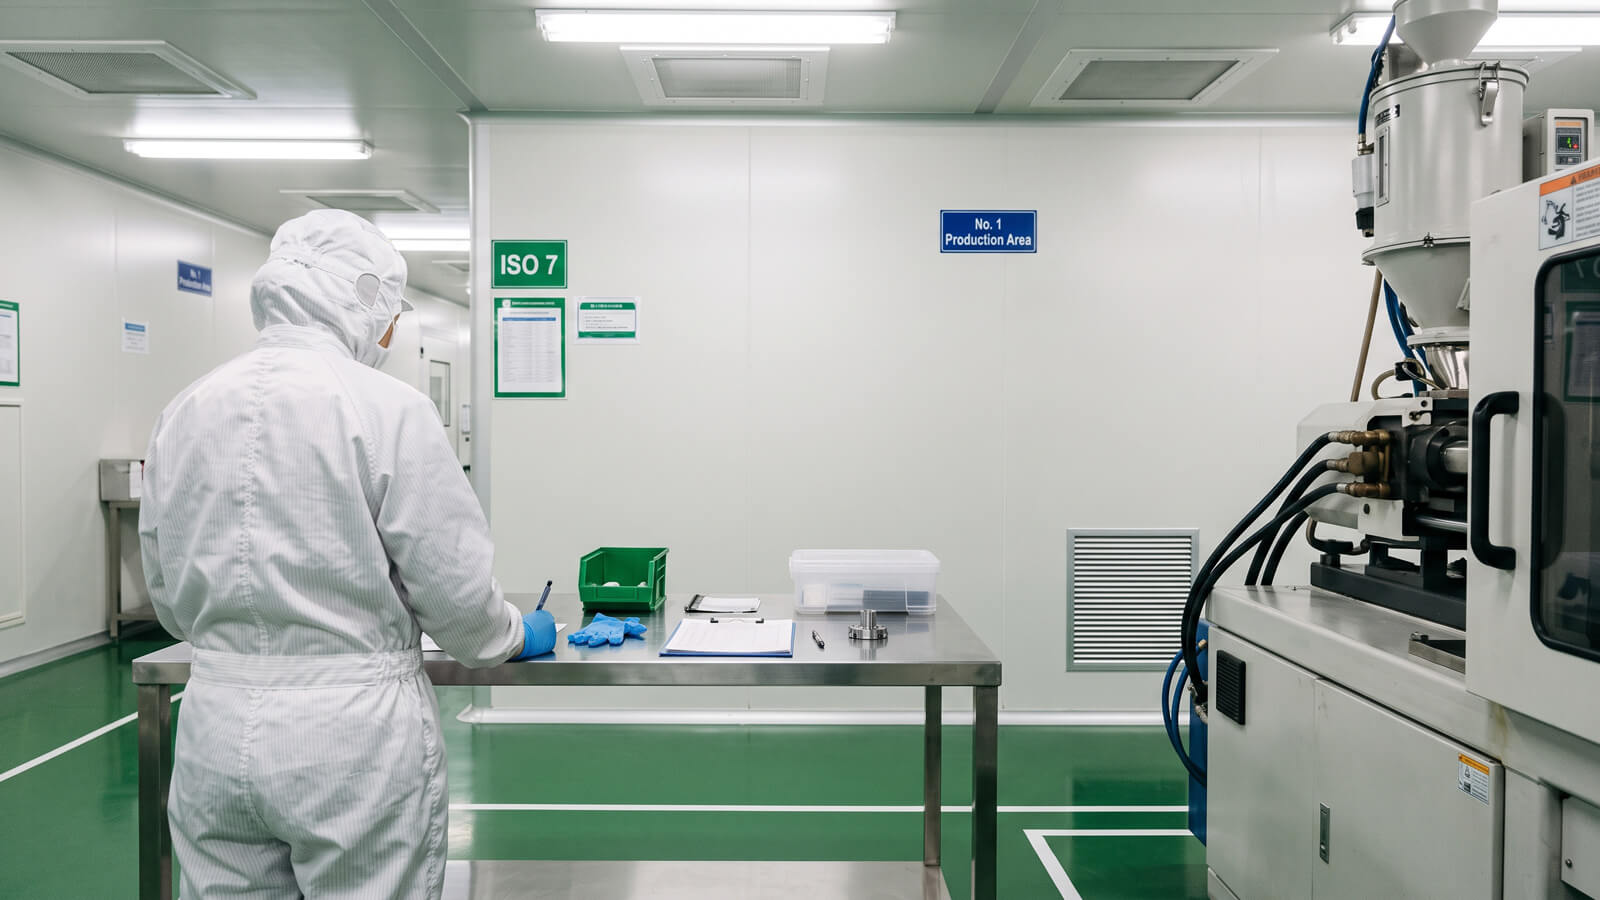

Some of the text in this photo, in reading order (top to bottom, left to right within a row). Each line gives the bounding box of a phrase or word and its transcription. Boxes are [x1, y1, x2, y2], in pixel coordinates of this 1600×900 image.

[975, 218, 1002, 230] No. 1
[945, 233, 1032, 246] Production Area
[501, 254, 558, 275] ISO 7
